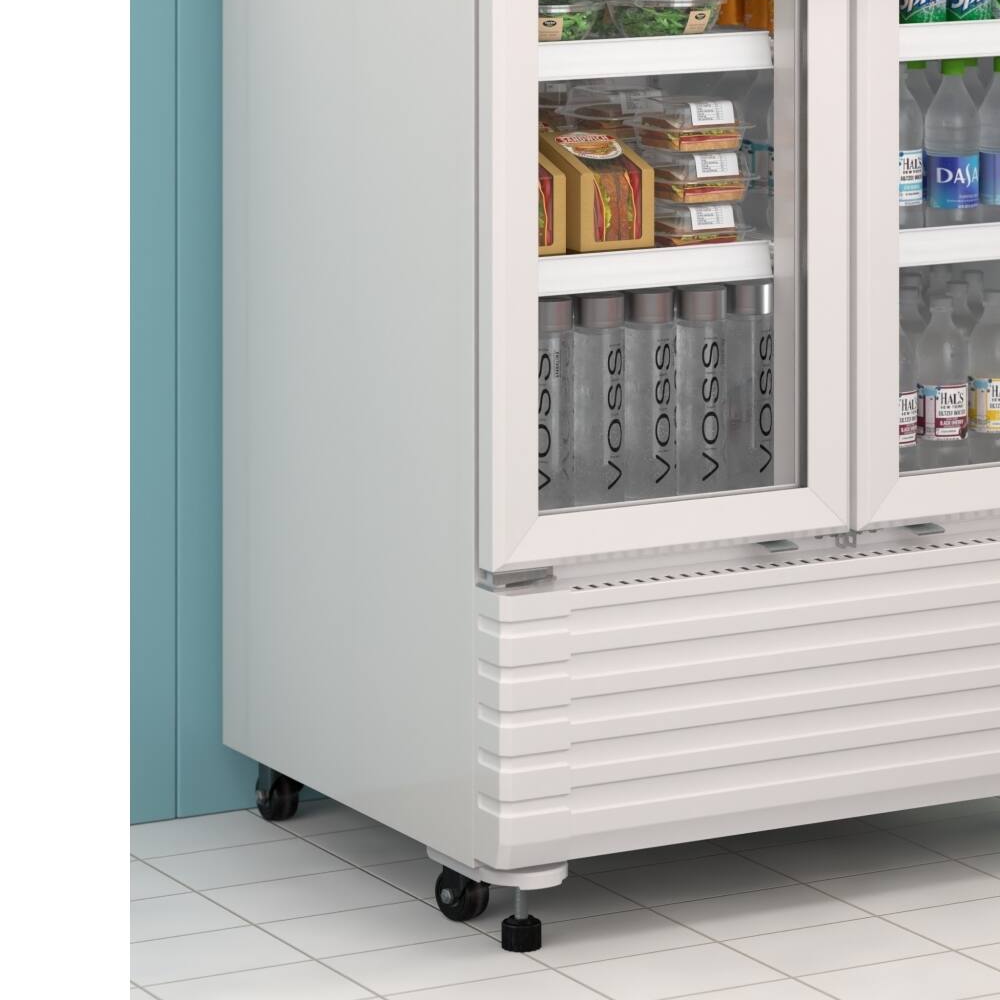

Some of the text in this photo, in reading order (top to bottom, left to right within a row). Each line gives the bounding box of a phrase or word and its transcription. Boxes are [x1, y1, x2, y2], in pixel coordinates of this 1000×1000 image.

[608, 348, 623, 490] VOSS
[655, 343, 671, 484] VOSS
[702, 341, 720, 482] VOSS
[759, 334, 773, 473] VOSS
[941, 391, 964, 405] HAL'S
